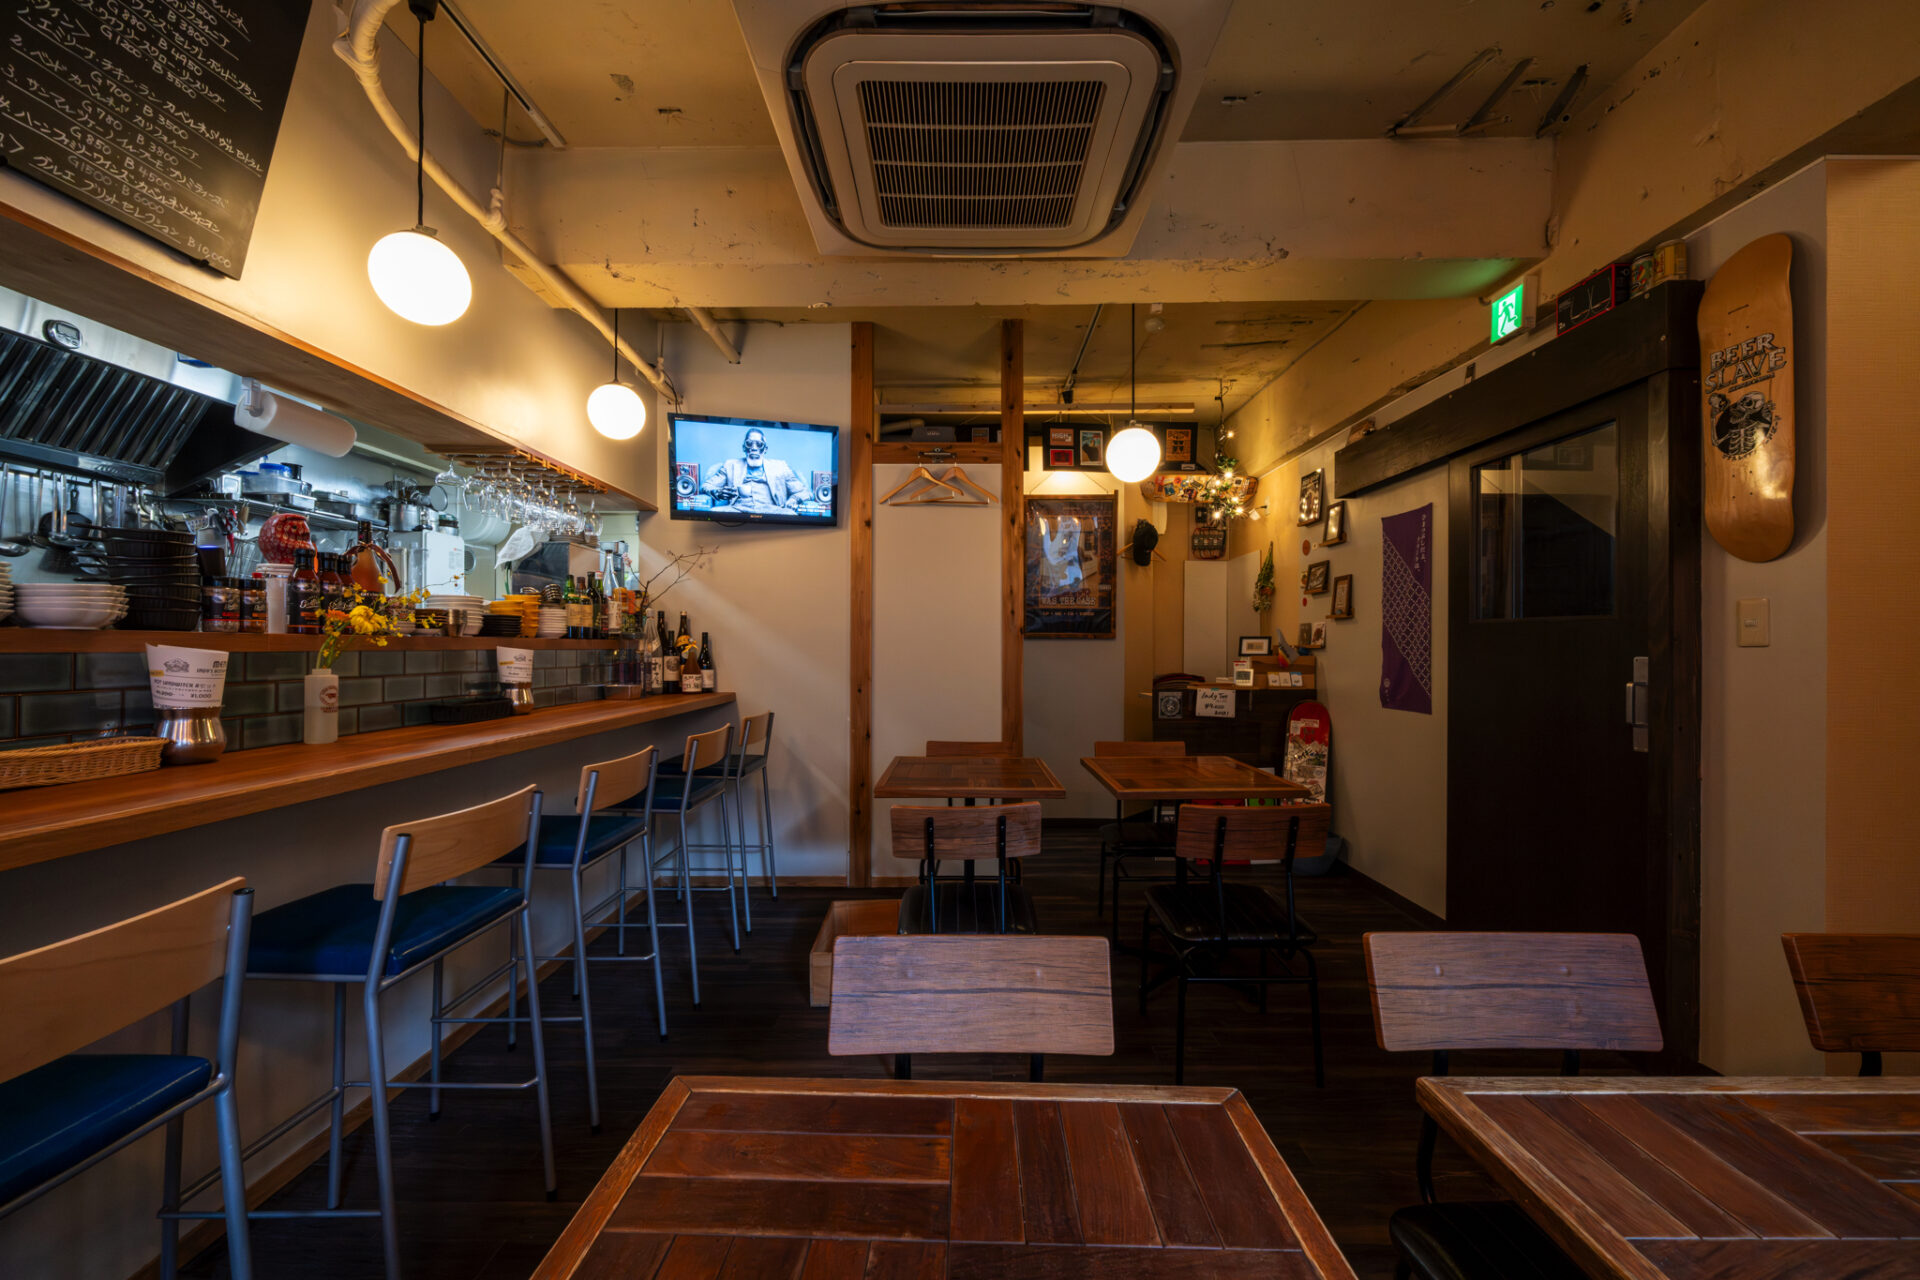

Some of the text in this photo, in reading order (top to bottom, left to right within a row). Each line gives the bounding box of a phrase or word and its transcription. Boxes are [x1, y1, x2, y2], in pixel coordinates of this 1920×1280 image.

[158, 114, 189, 140] 3500
[149, 141, 180, 166] 3800
[1710, 333, 1779, 372] BEER
[1705, 346, 1788, 394] SLAVE
